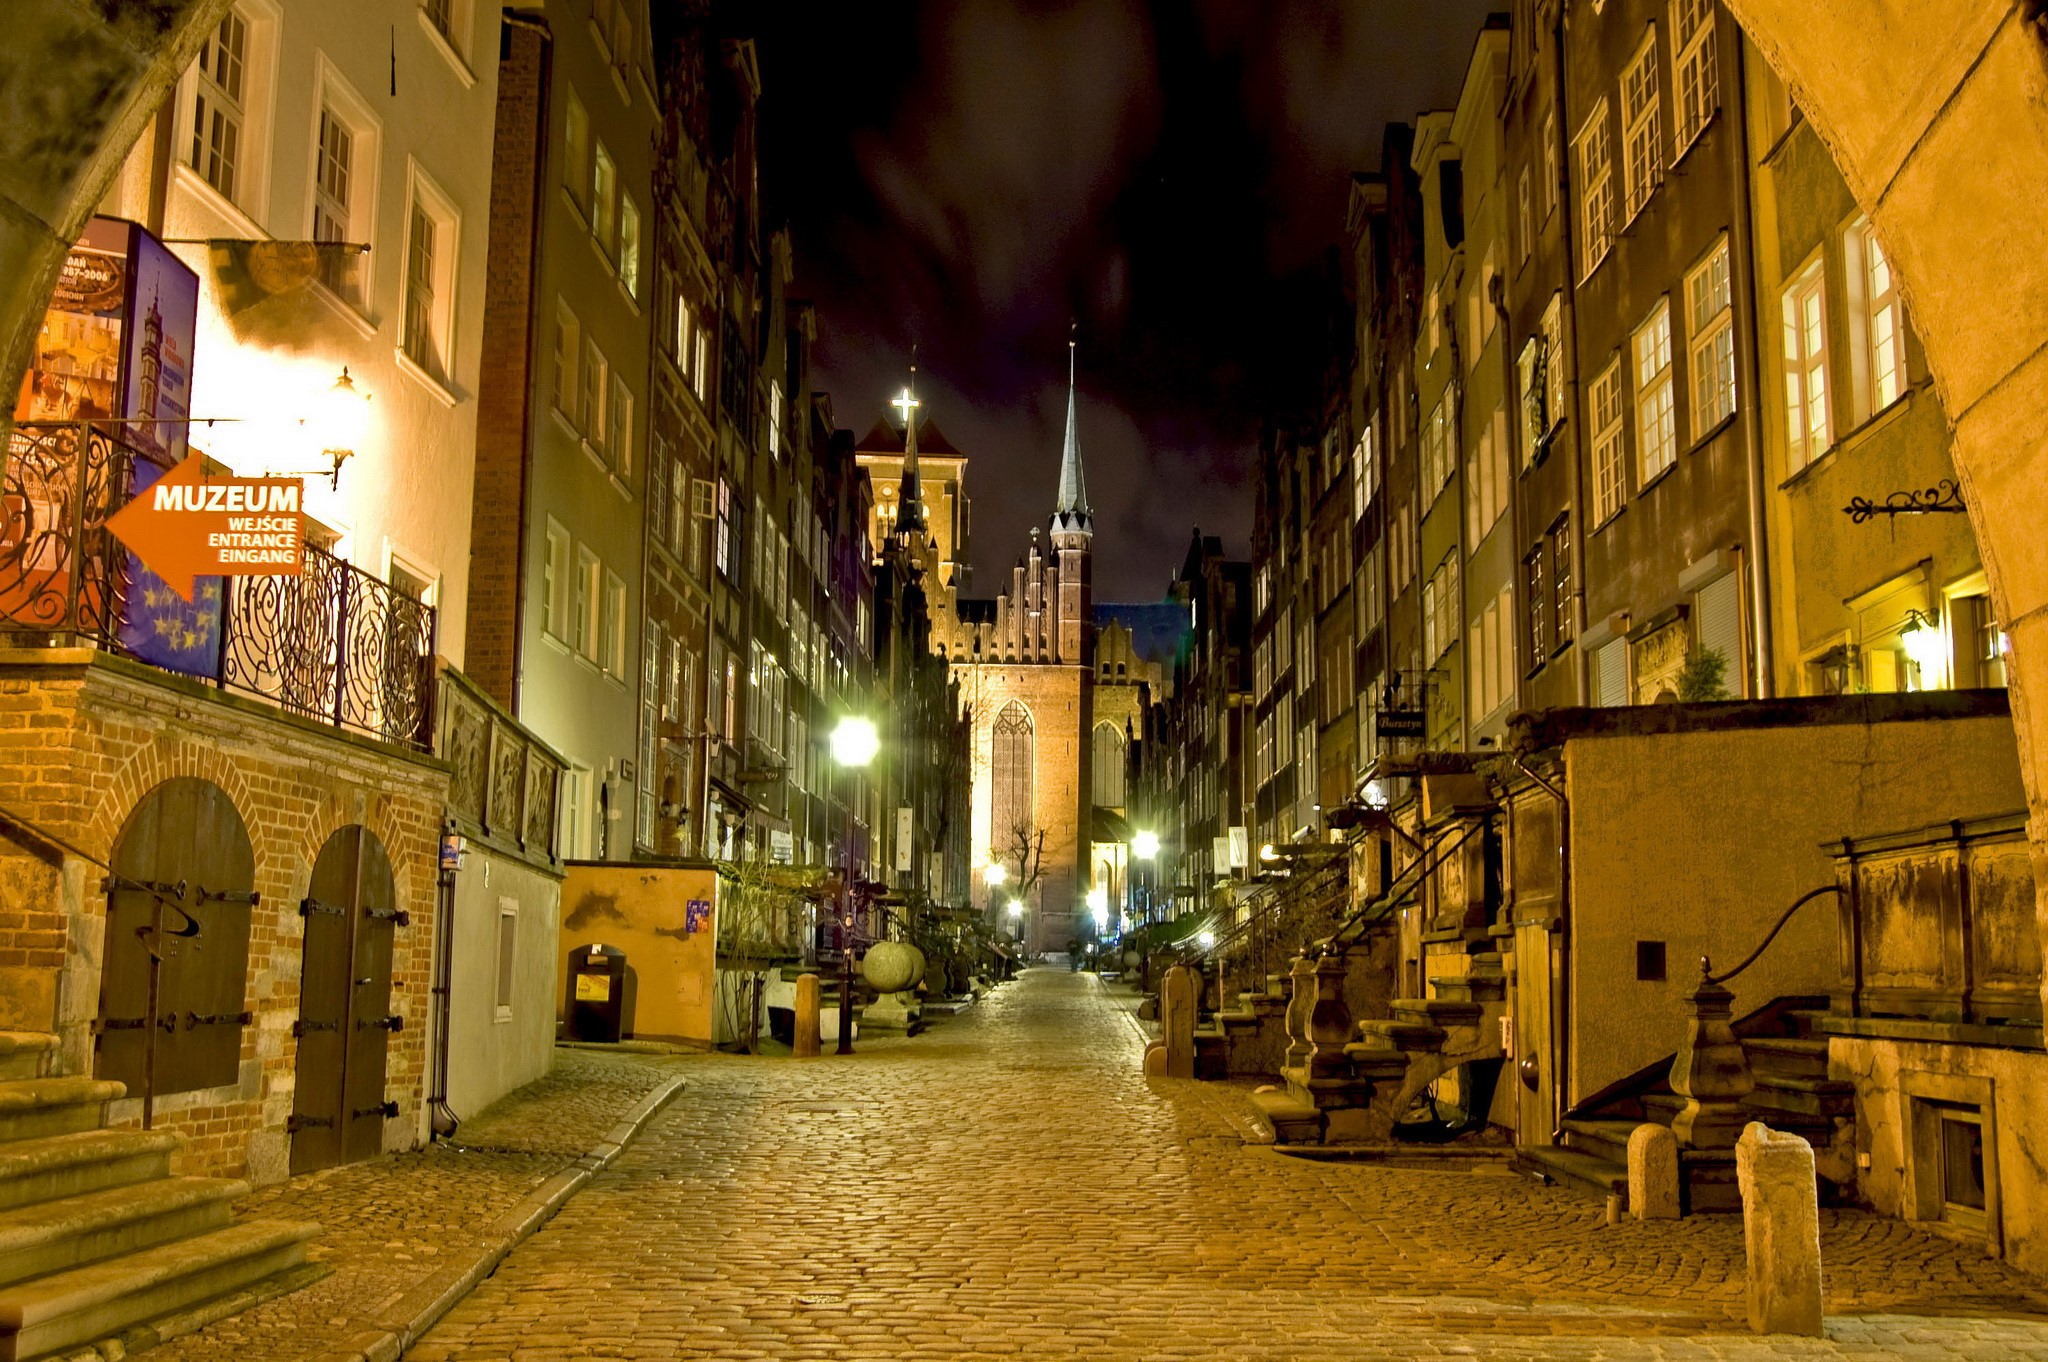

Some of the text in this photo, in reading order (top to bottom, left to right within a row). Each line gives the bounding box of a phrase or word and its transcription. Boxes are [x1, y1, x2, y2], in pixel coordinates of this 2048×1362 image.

[154, 485, 299, 512] MUZEUM
[229, 515, 298, 532] WEJŚCIE
[209, 533, 297, 548] ENTRANCE
[219, 549, 296, 564] EINGANG
